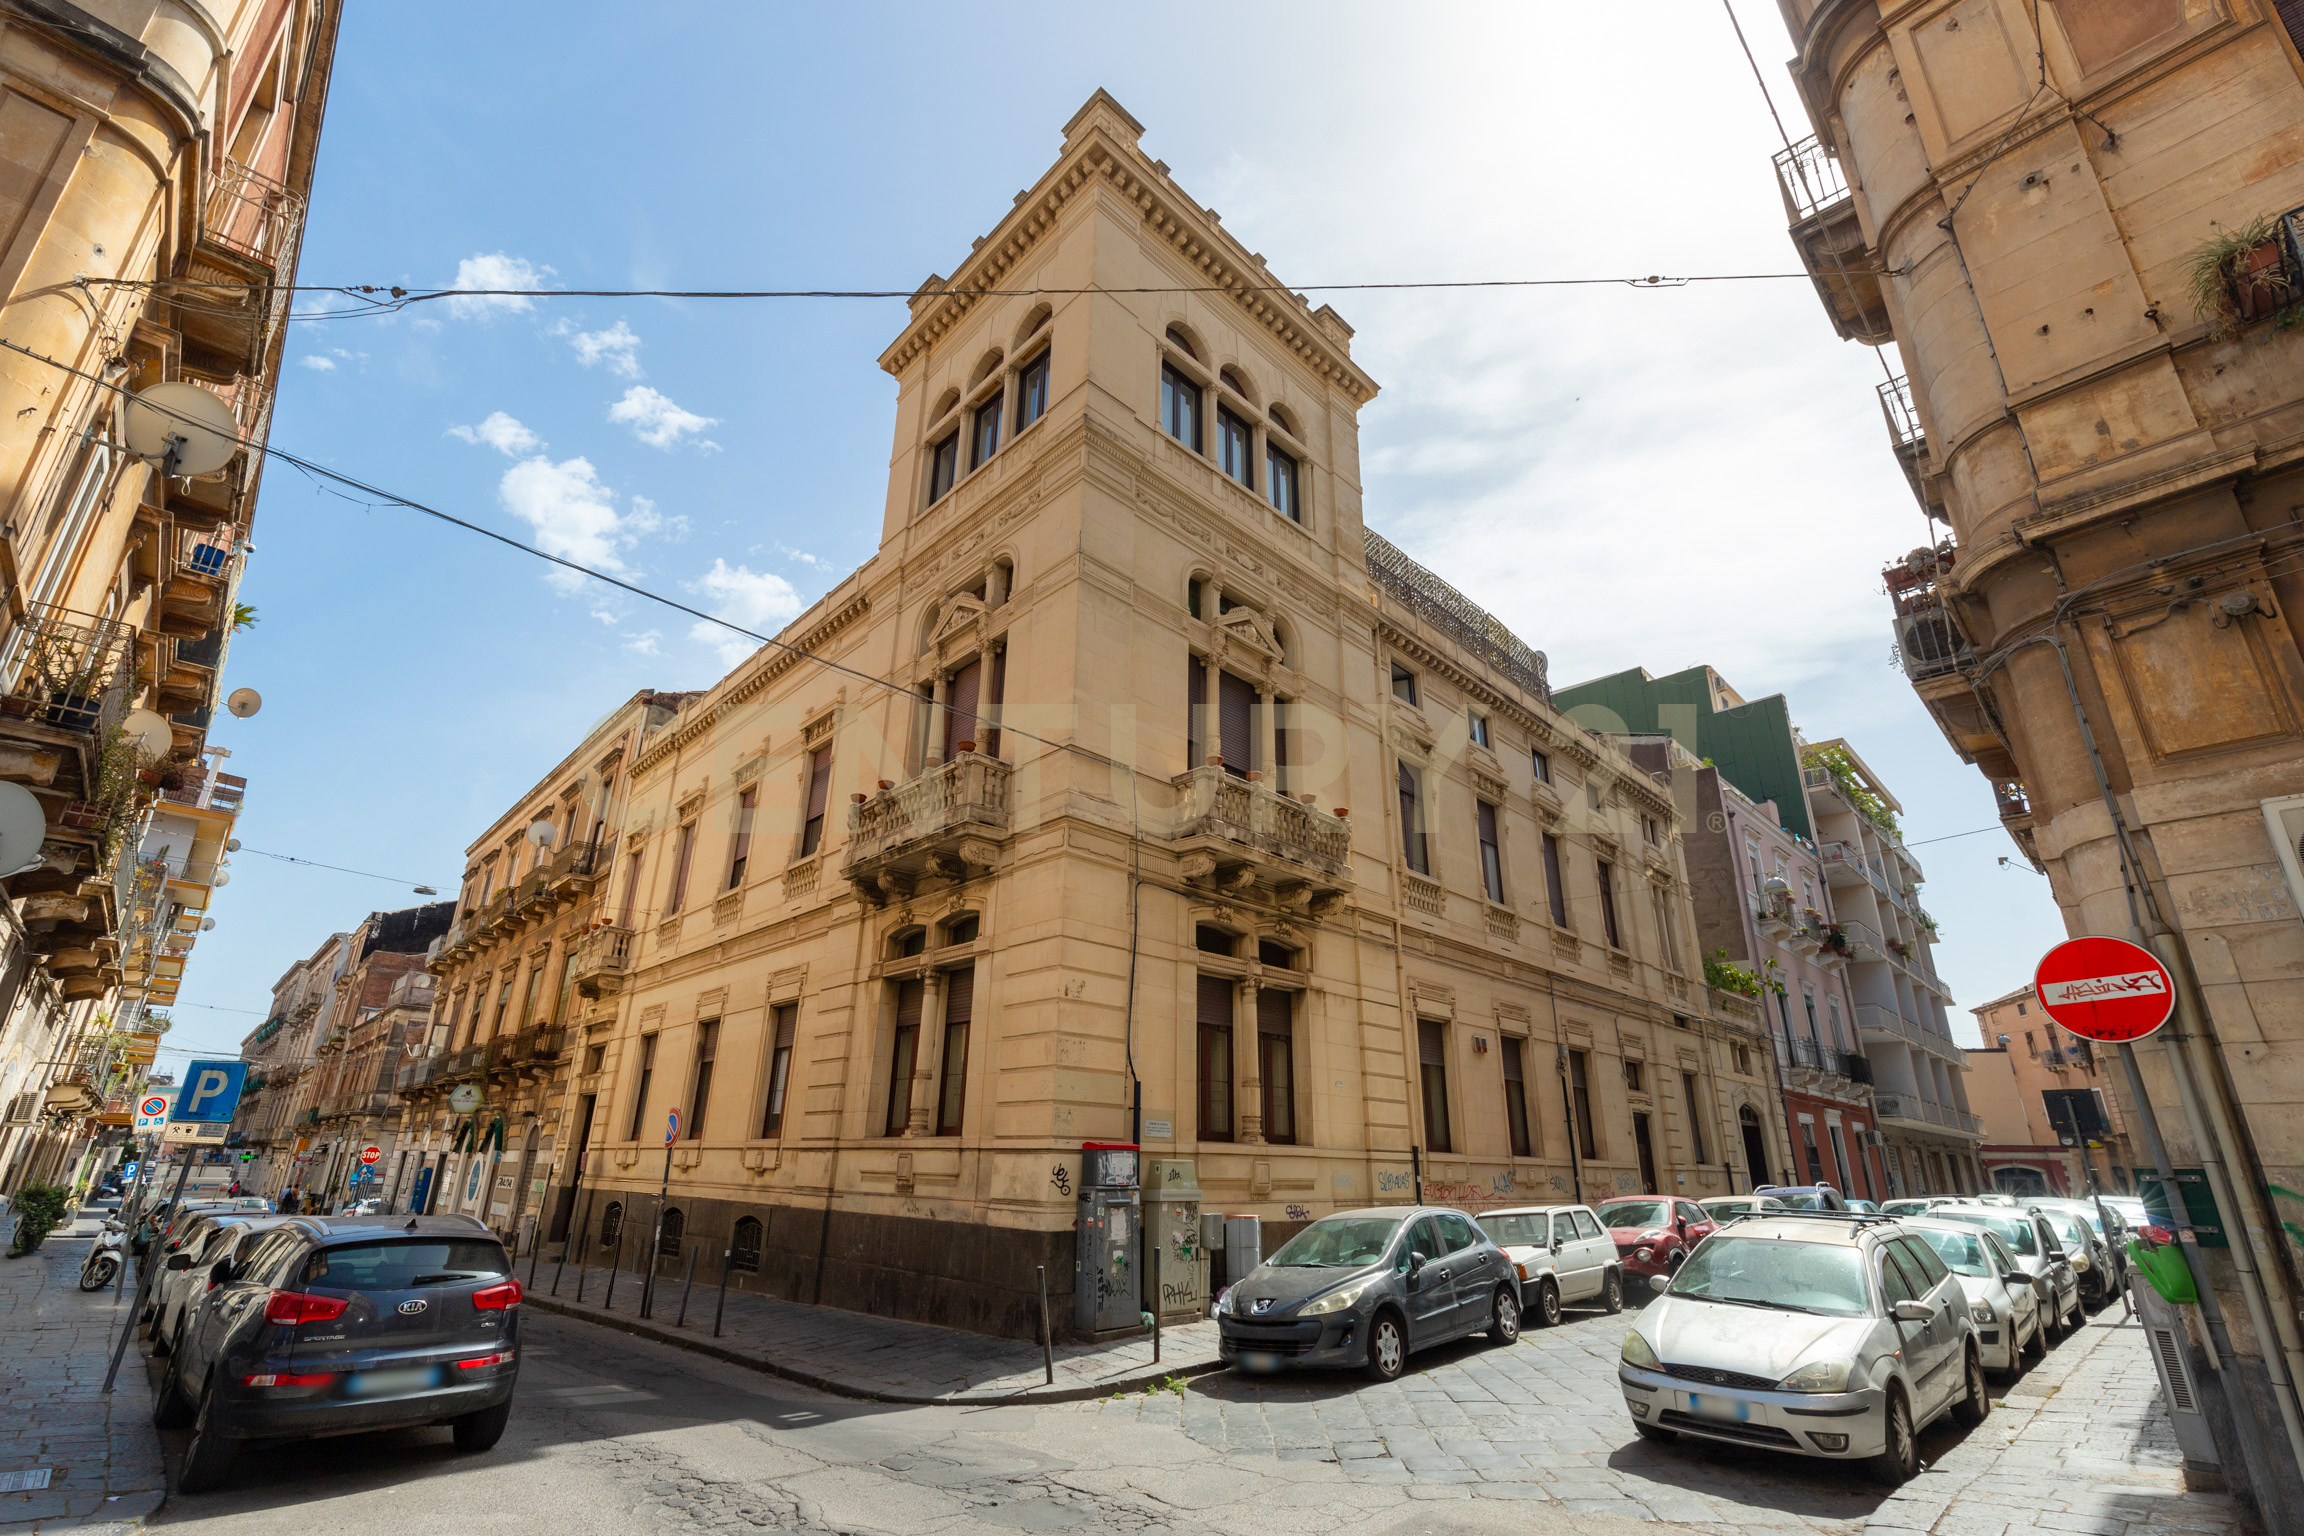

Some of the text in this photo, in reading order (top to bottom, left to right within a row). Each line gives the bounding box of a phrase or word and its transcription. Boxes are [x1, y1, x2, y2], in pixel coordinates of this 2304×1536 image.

[188, 1070, 228, 1112] P
[362, 1151, 380, 1159] STOP
[127, 1165, 136, 1176] P
[402, 1302, 423, 1312] KIA
[303, 1334, 346, 1342] SPORTAGE
